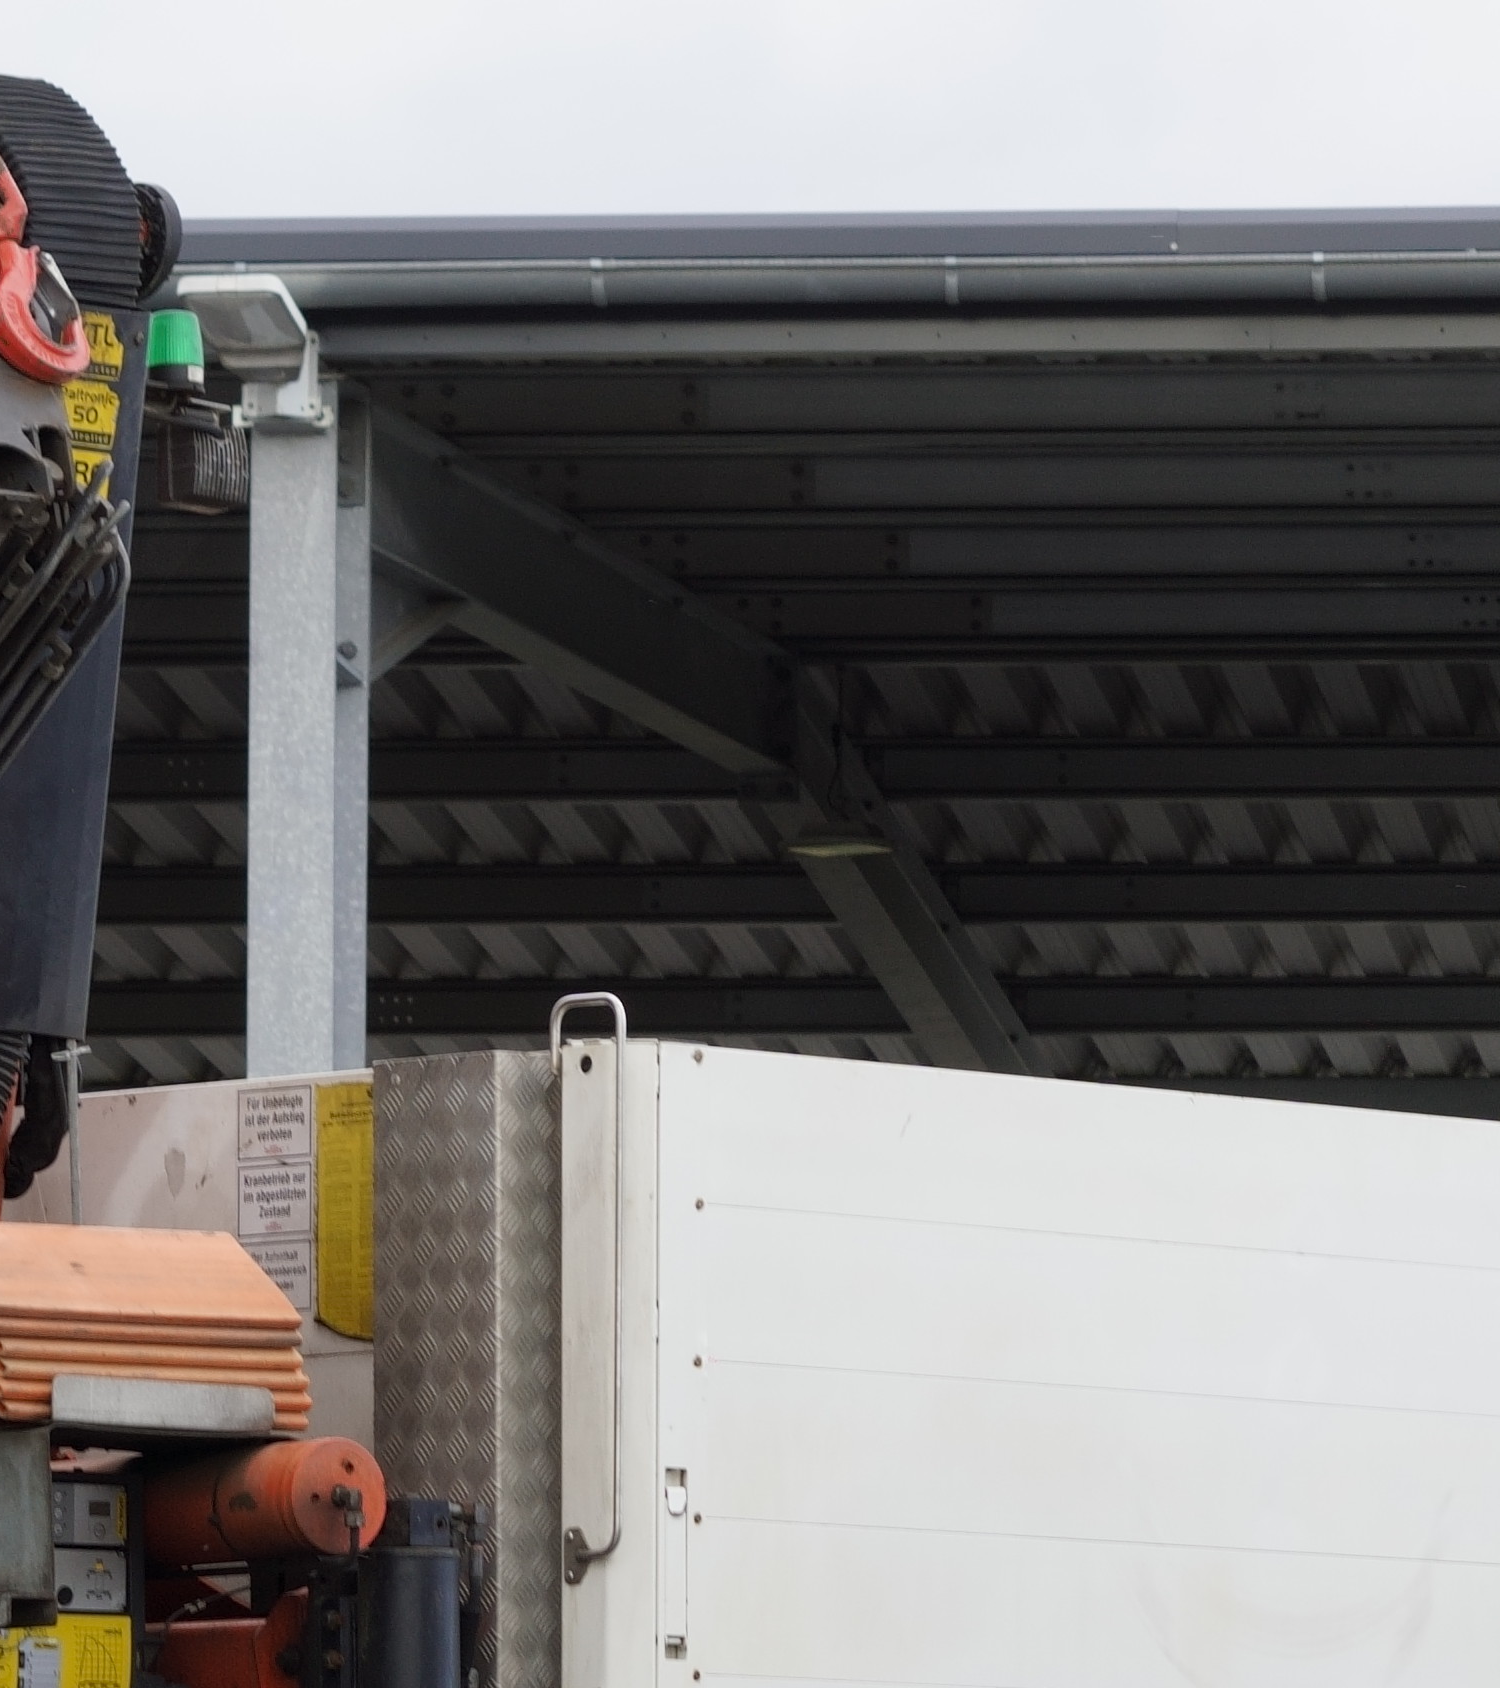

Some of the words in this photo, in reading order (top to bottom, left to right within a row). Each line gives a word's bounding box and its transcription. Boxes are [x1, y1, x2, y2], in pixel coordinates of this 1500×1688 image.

[73, 405, 99, 424] 50
[246, 1096, 260, 1111] Für
[262, 1094, 303, 1111] Unbefugte
[244, 1113, 255, 1128] ist
[257, 1112, 270, 1126] der
[271, 1110, 305, 1126] Aufstieg
[256, 1128, 293, 1142] verboten
[243, 1170, 290, 1187] Kranbetrieb
[255, 1187, 307, 1204] abgestützten
[259, 1203, 291, 1218] Zustand
